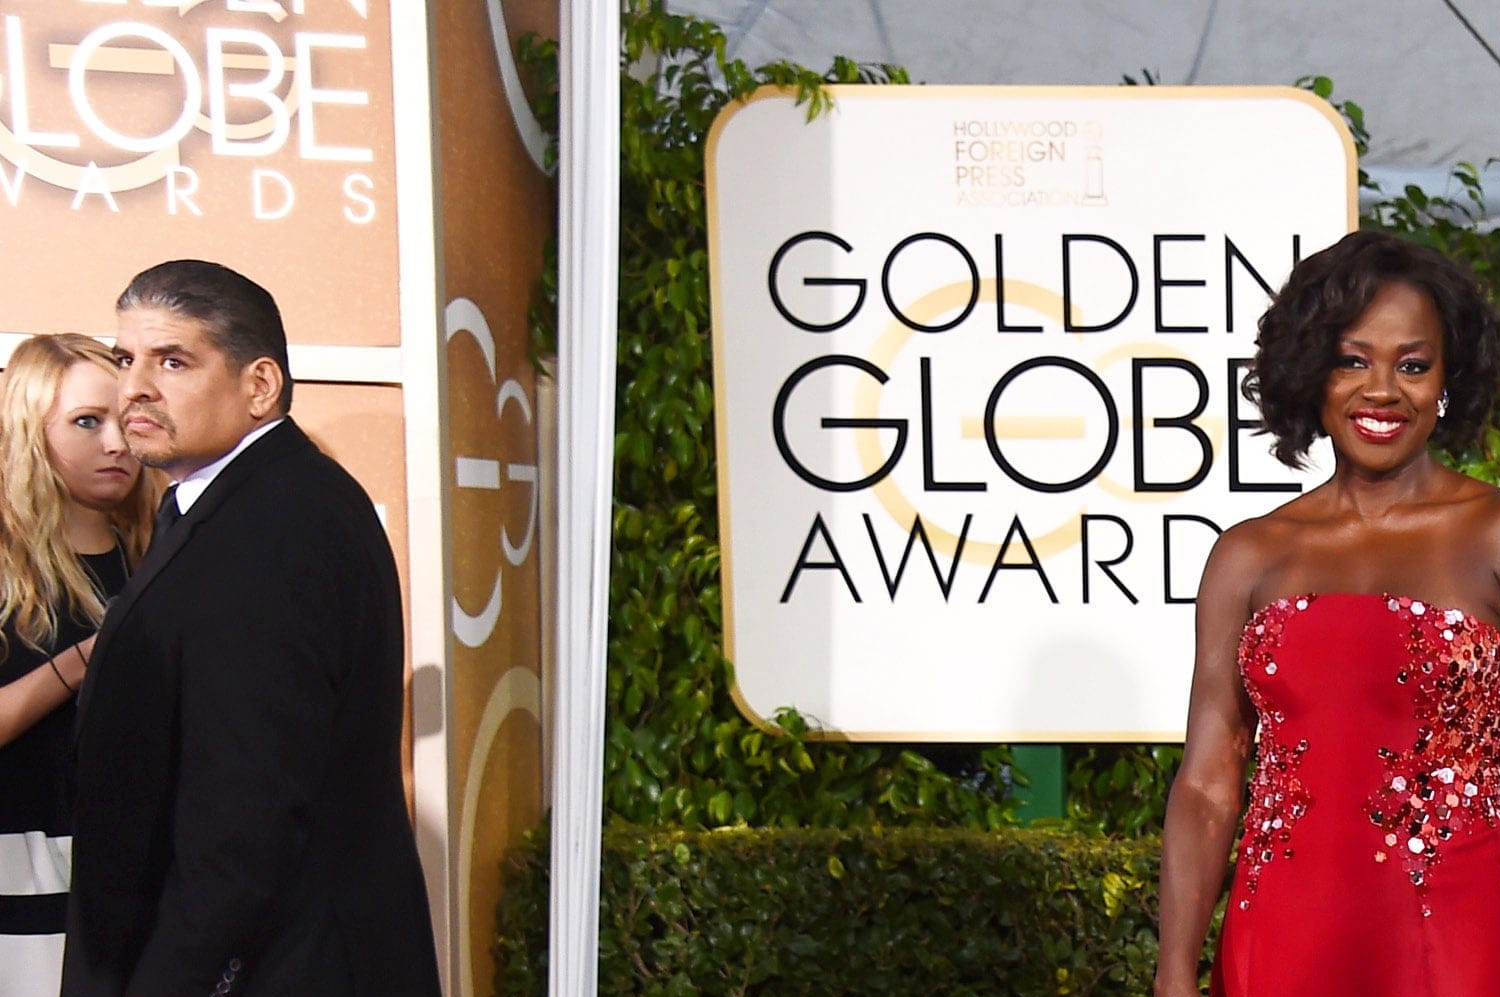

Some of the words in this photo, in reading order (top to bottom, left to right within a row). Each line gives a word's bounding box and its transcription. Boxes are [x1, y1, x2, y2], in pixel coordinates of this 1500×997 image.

[0, 15, 374, 163] LOBE
[953, 120, 1078, 138] HOLLYWOOD
[955, 140, 1066, 163] FOREIGN
[955, 165, 1026, 188] PRESS
[768, 231, 1301, 334] GOLDEN
[773, 354, 1304, 494] GLOBE
[779, 513, 1226, 605] AWARD
